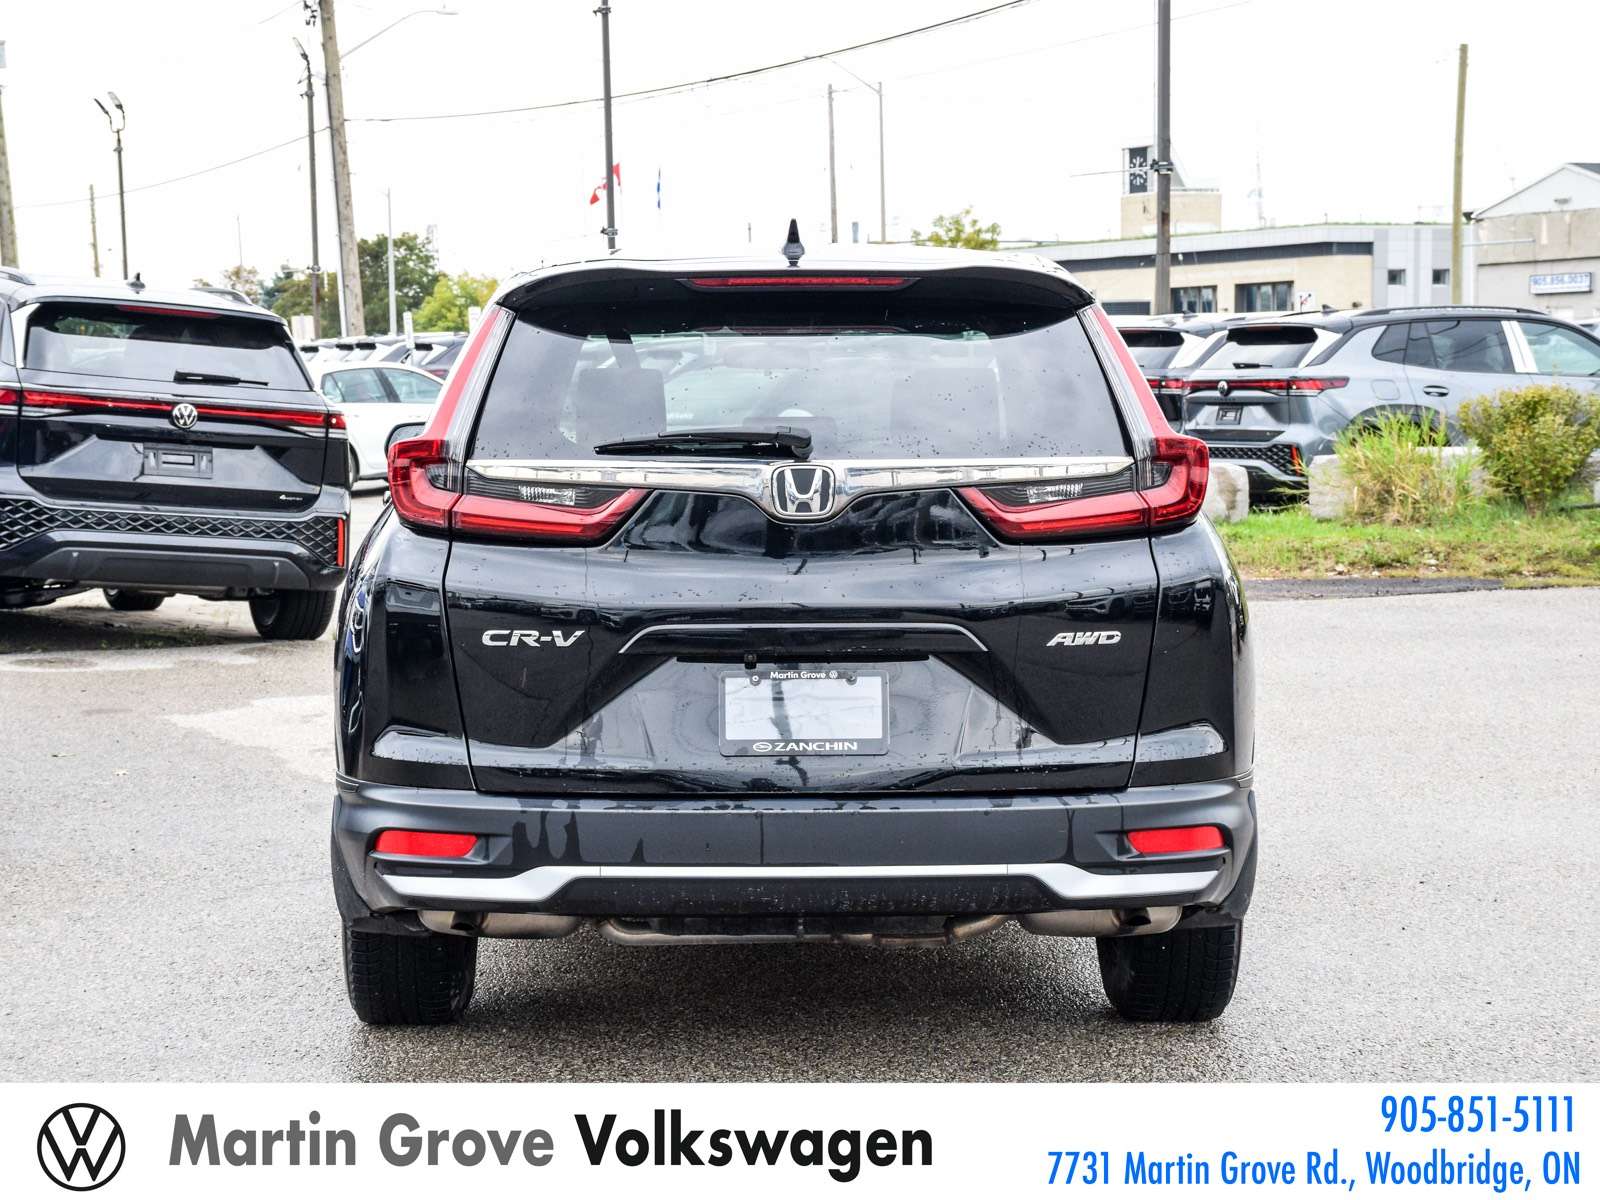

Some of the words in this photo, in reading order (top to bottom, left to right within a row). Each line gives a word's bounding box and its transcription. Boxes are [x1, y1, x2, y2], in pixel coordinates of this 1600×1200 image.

[481, 629, 585, 647] CR-V
[1046, 630, 1121, 646] AWD
[770, 671, 799, 680] Martin
[801, 671, 826, 680] Grove
[774, 742, 858, 751] ZANCHIN
